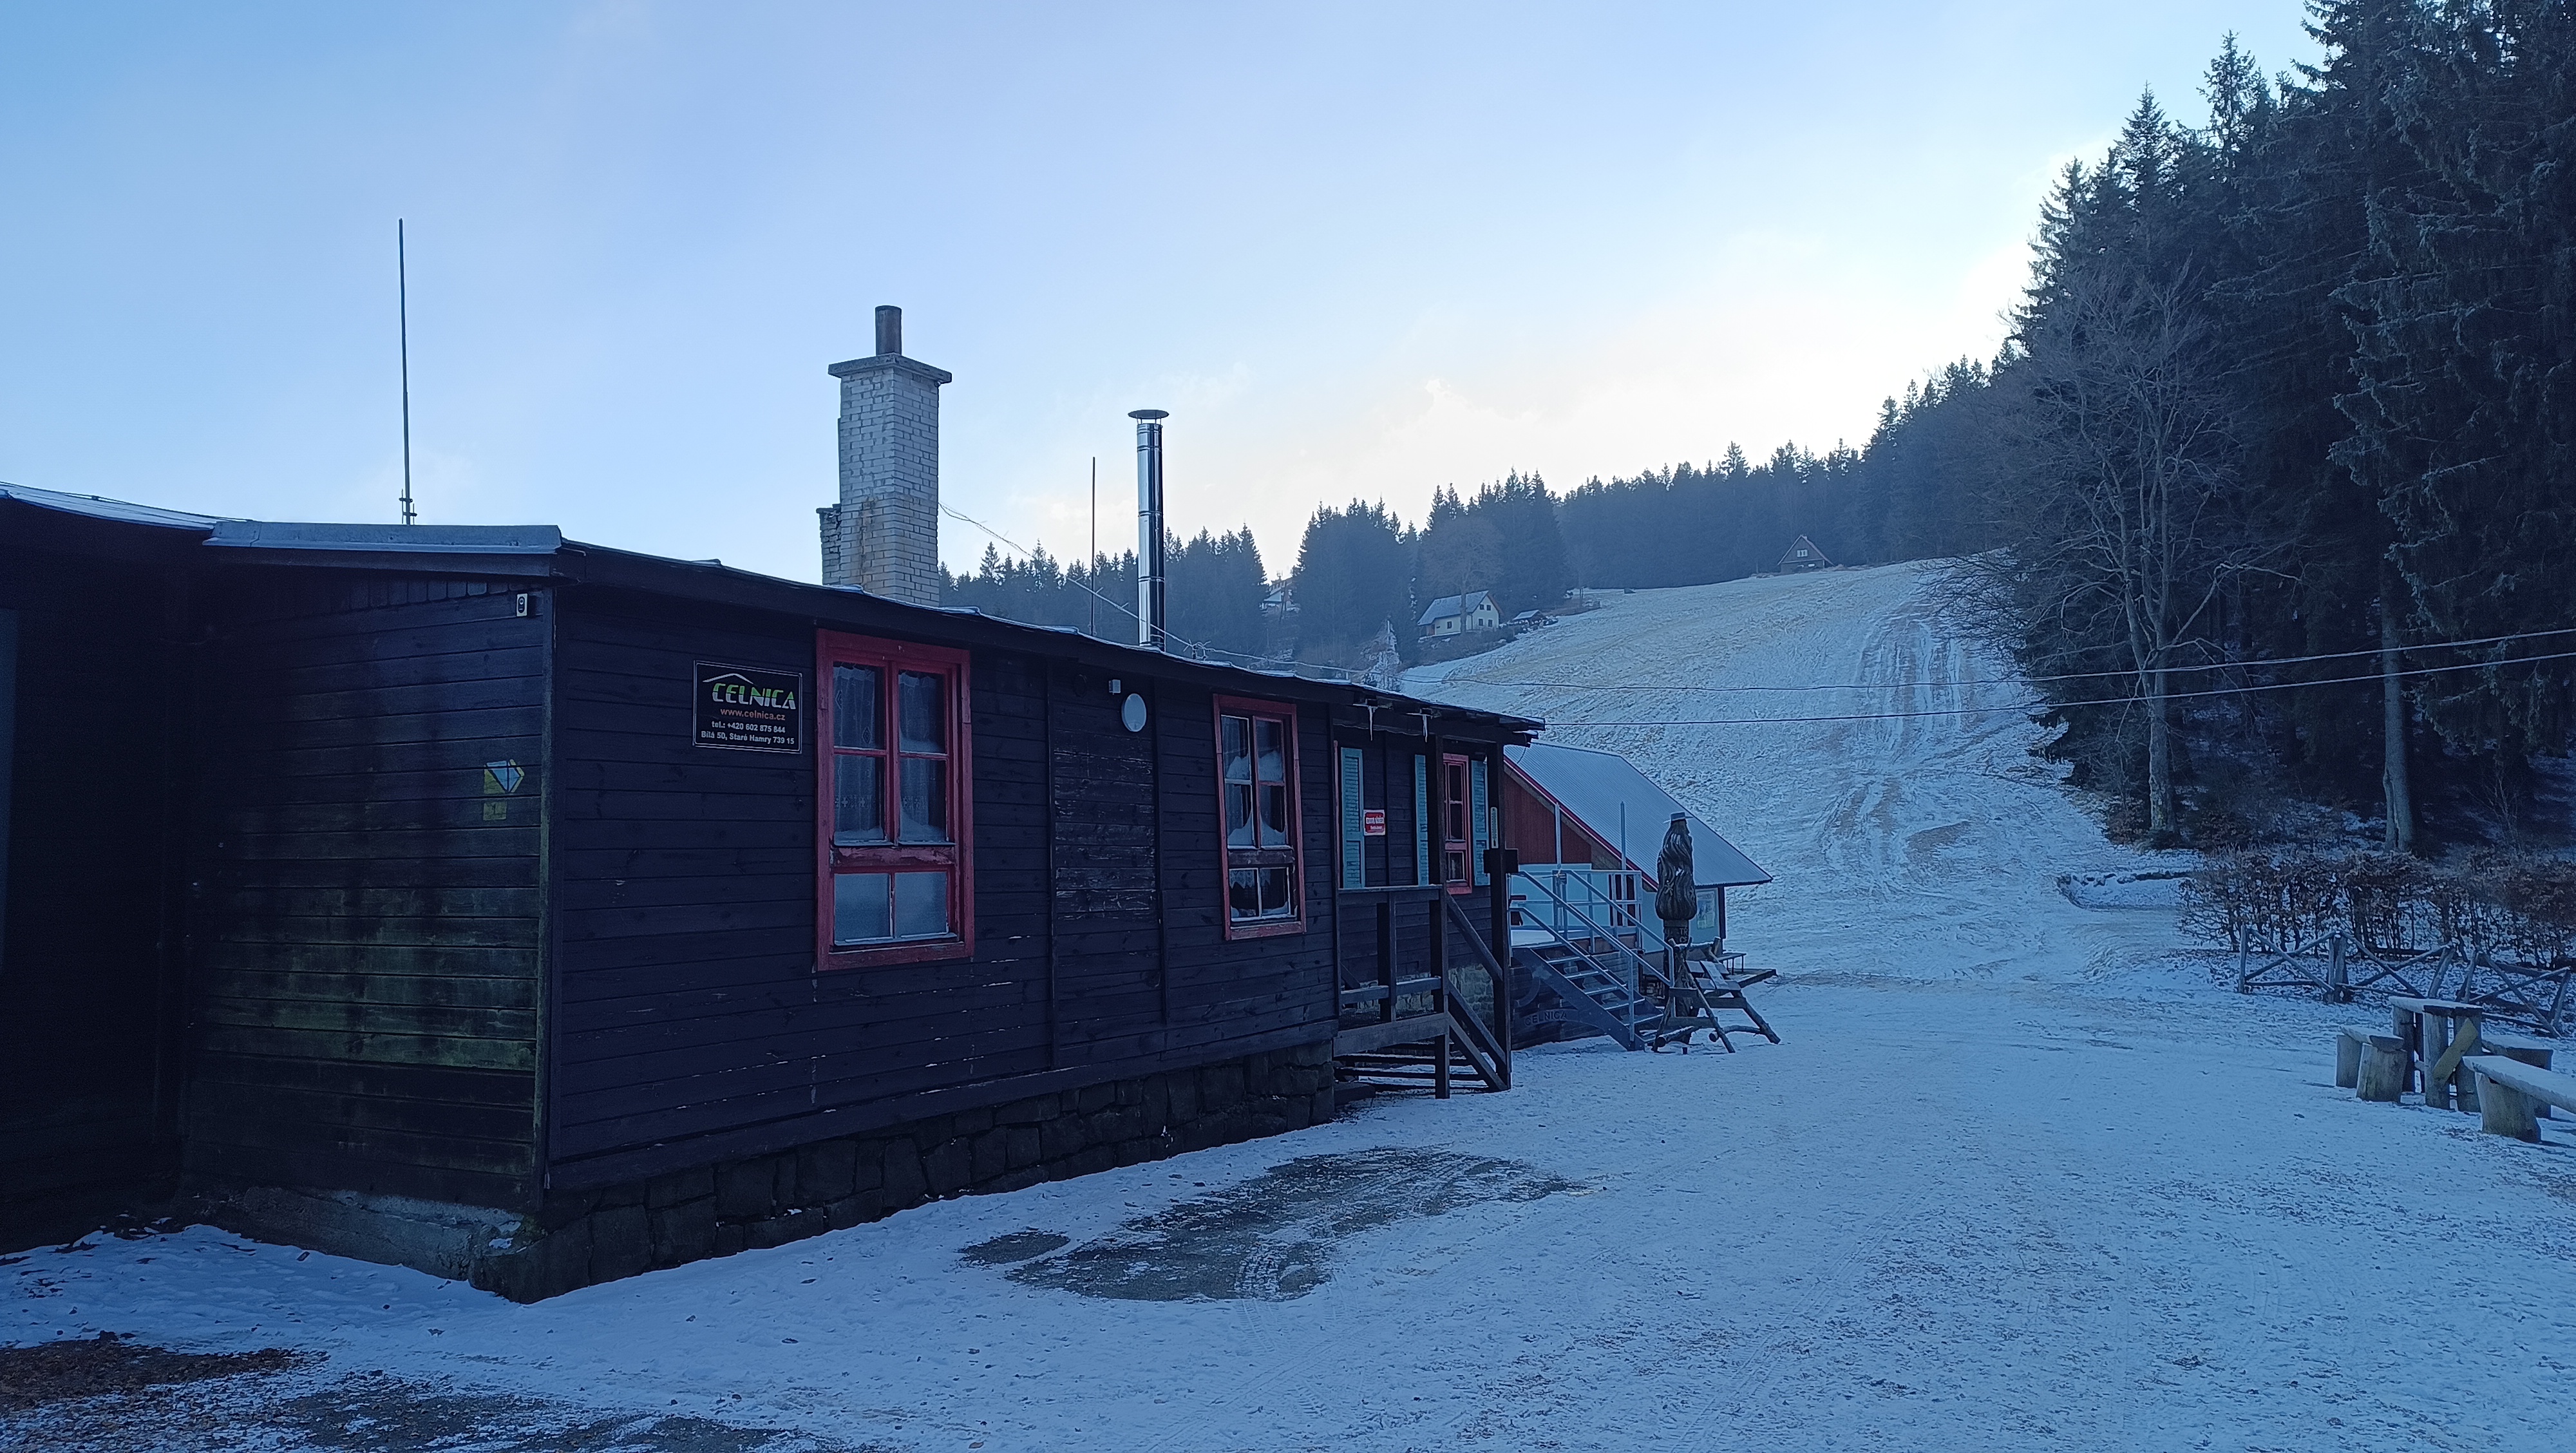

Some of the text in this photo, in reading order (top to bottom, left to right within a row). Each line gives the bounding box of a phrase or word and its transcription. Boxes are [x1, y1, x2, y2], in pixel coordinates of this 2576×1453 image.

[712, 683, 797, 710] CELNICA
[720, 708, 786, 721] www.celnica.cz
[745, 723, 758, 732] 602
[749, 734, 772, 745] Hamry
[772, 736, 785, 744] 739
[1524, 1011, 1567, 1026] CELNICA
